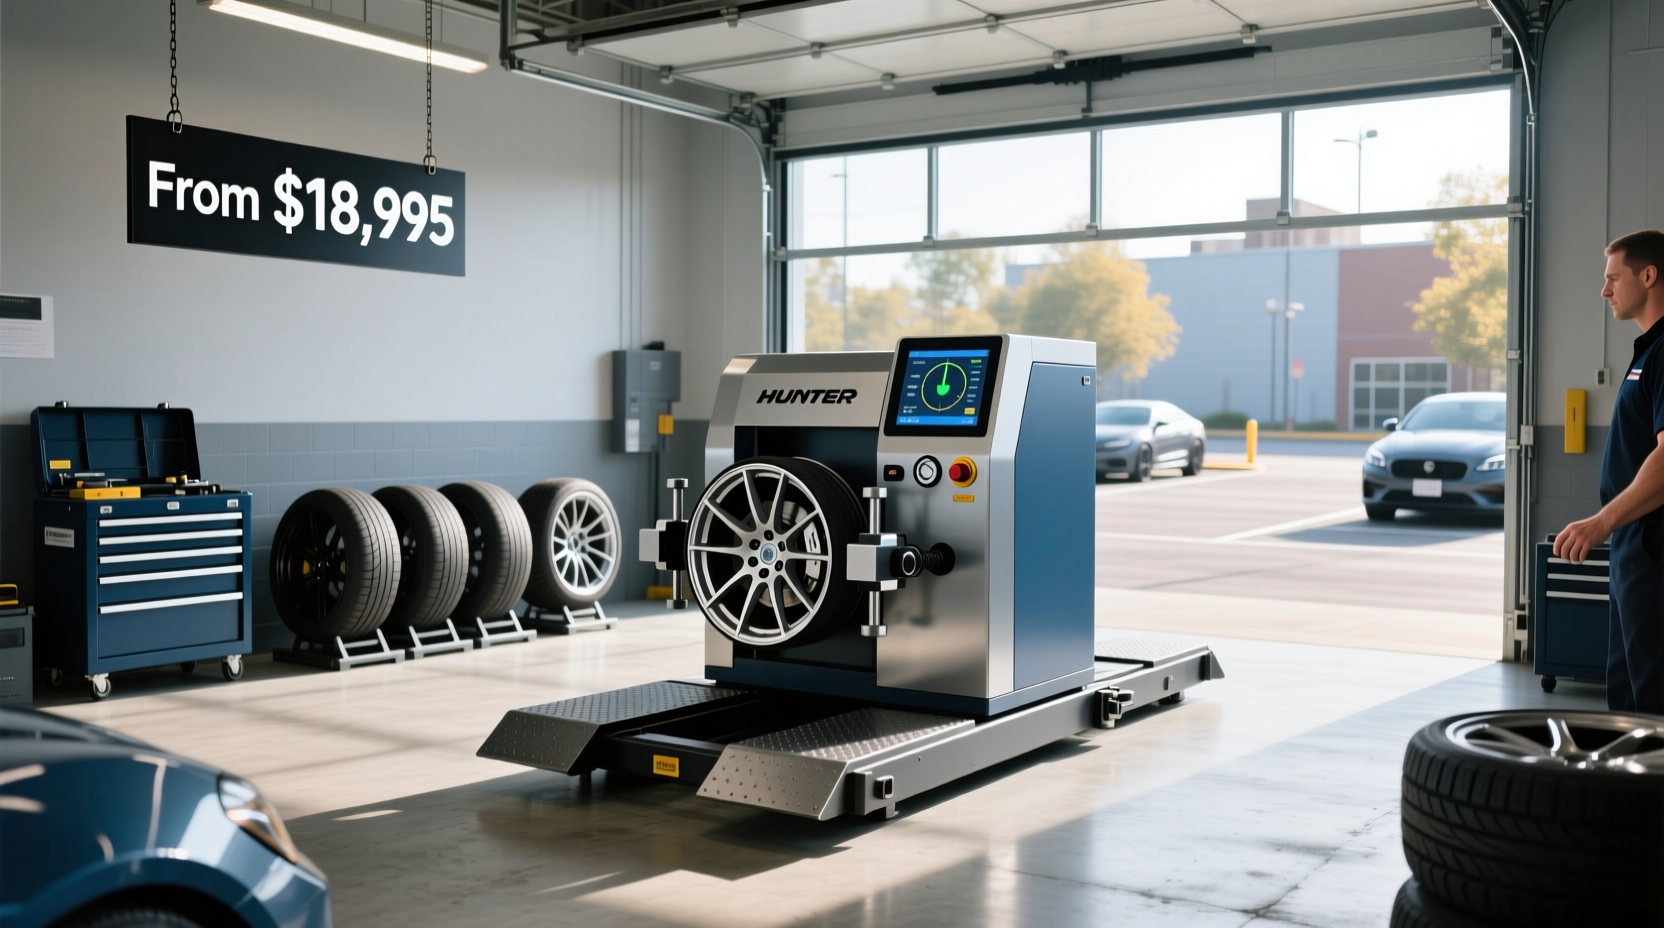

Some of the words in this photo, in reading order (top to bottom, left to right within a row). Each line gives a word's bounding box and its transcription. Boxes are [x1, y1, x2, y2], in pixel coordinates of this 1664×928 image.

[149, 160, 260, 221] From
[273, 167, 455, 247] $18,995
[756, 388, 858, 405] HUNTER
